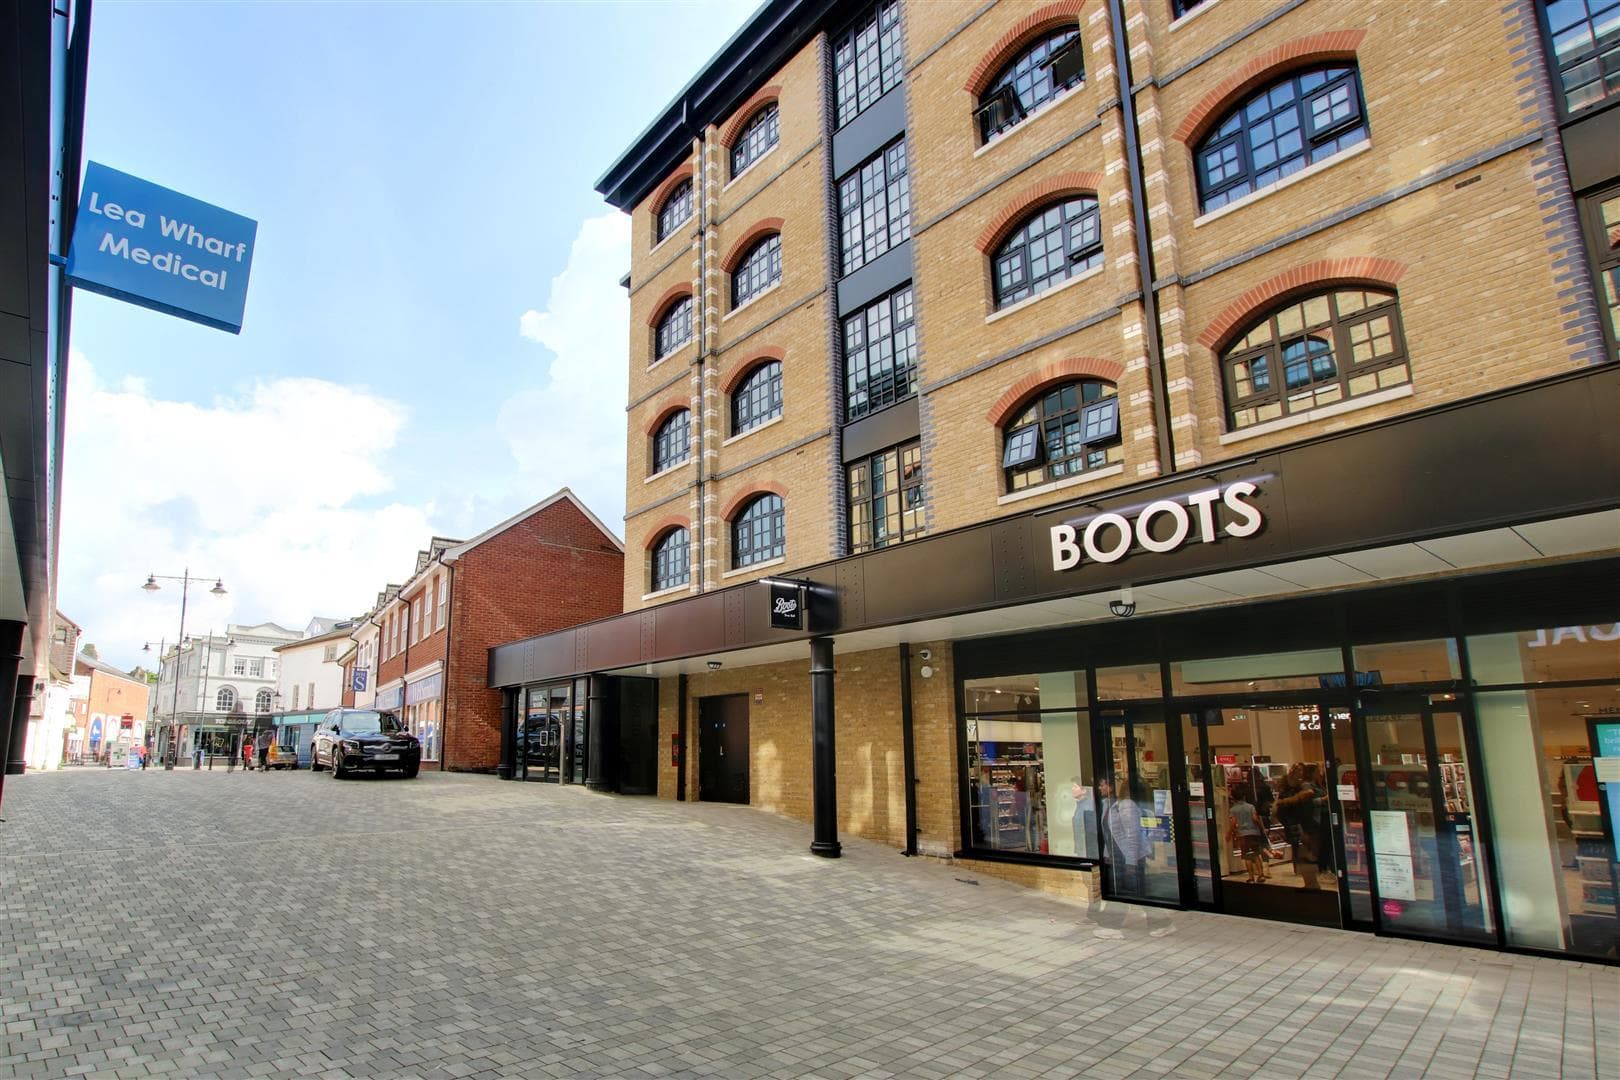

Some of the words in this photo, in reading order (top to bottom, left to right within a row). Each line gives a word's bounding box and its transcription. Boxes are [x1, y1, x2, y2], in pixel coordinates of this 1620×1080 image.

[88, 191, 146, 229] Lea
[159, 215, 246, 263] Wharf
[98, 232, 228, 290] Medical
[1050, 481, 1262, 571] BOOTS
[773, 597, 797, 614] Boots
